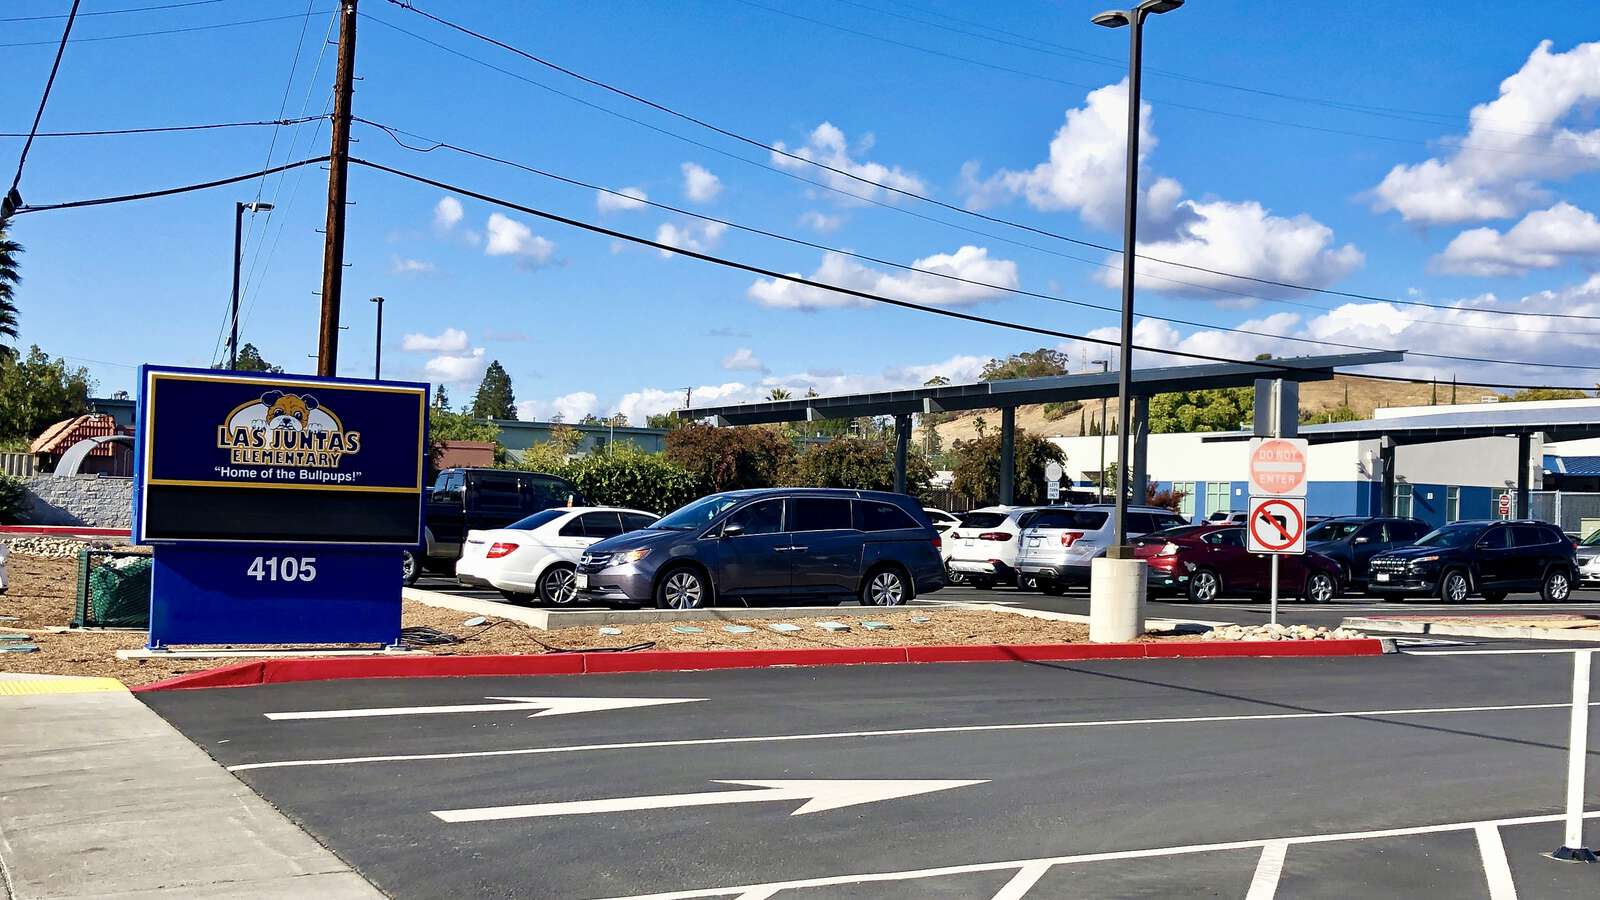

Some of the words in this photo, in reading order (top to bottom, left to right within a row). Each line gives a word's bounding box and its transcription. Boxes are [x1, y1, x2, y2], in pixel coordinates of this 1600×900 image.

[218, 426, 266, 449] LAS
[271, 429, 360, 453] JUNTAS
[231, 449, 341, 467] ELEMENTARY
[1259, 449, 1274, 460] DO
[1276, 449, 1297, 460] NOT
[260, 468, 274, 479] of
[276, 469, 296, 480] the
[1259, 474, 1296, 485] ENTER
[247, 556, 317, 582] 4105
